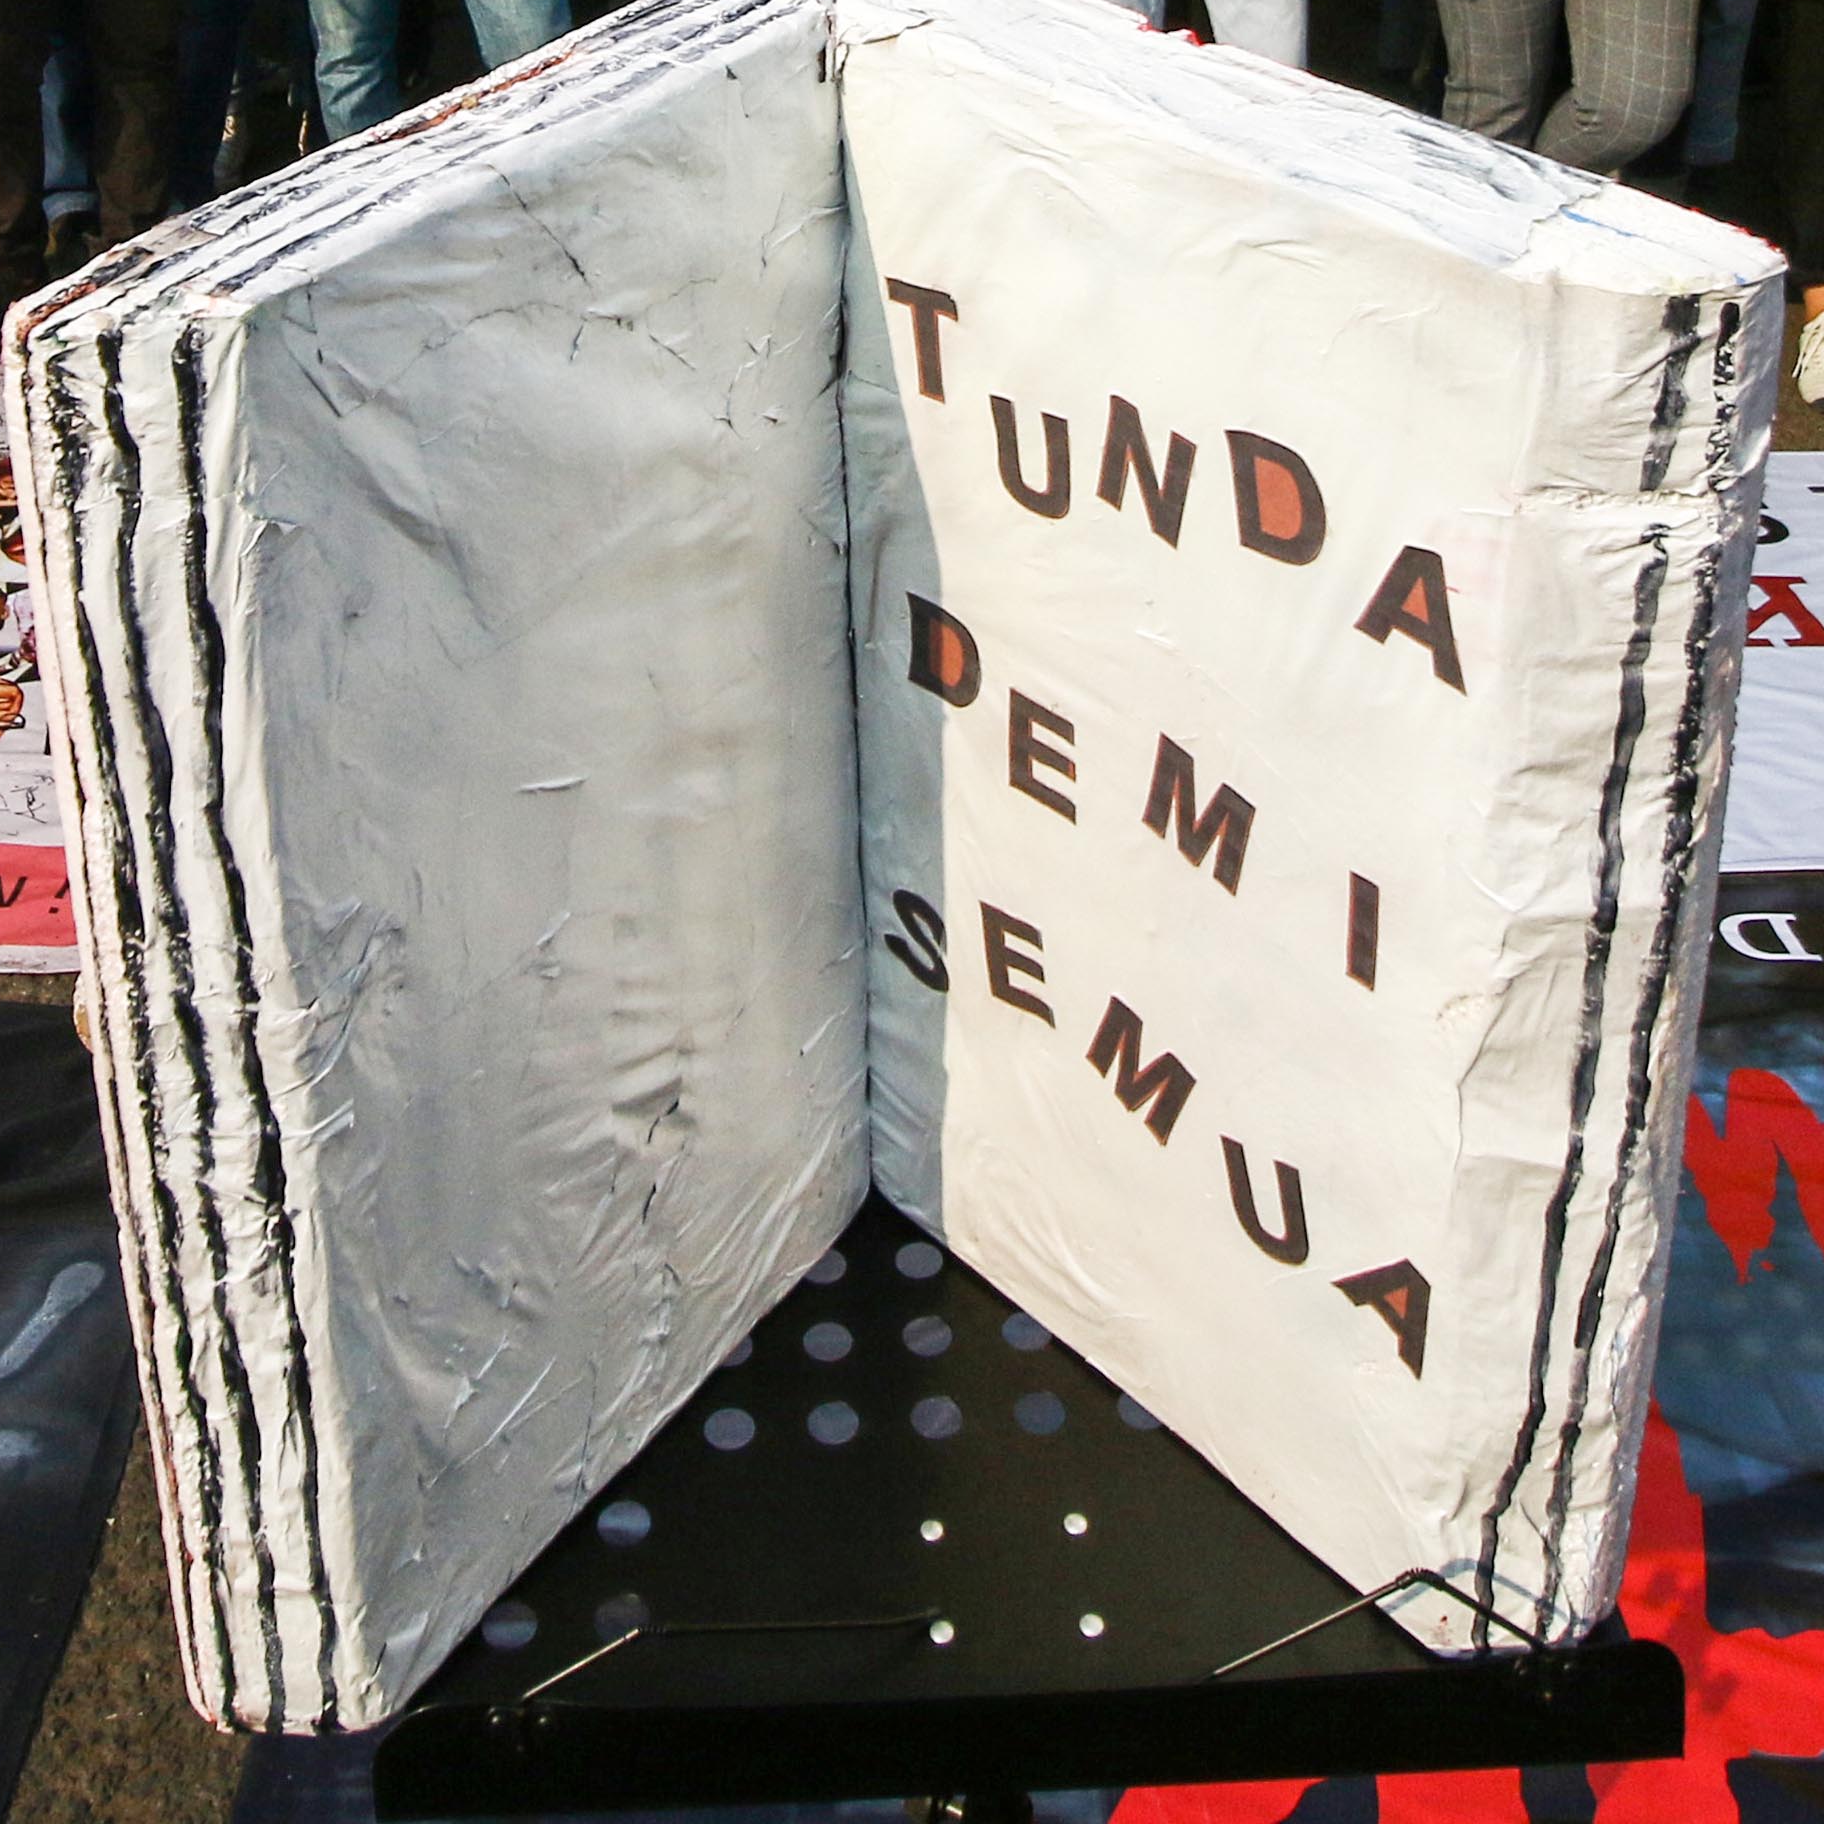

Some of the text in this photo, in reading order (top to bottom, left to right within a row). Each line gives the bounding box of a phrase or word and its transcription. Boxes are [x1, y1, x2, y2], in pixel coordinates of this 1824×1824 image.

[885, 276, 1468, 697] TUNDA
[906, 591, 1380, 993] DEMI
[882, 888, 1433, 1382] SEMUA
